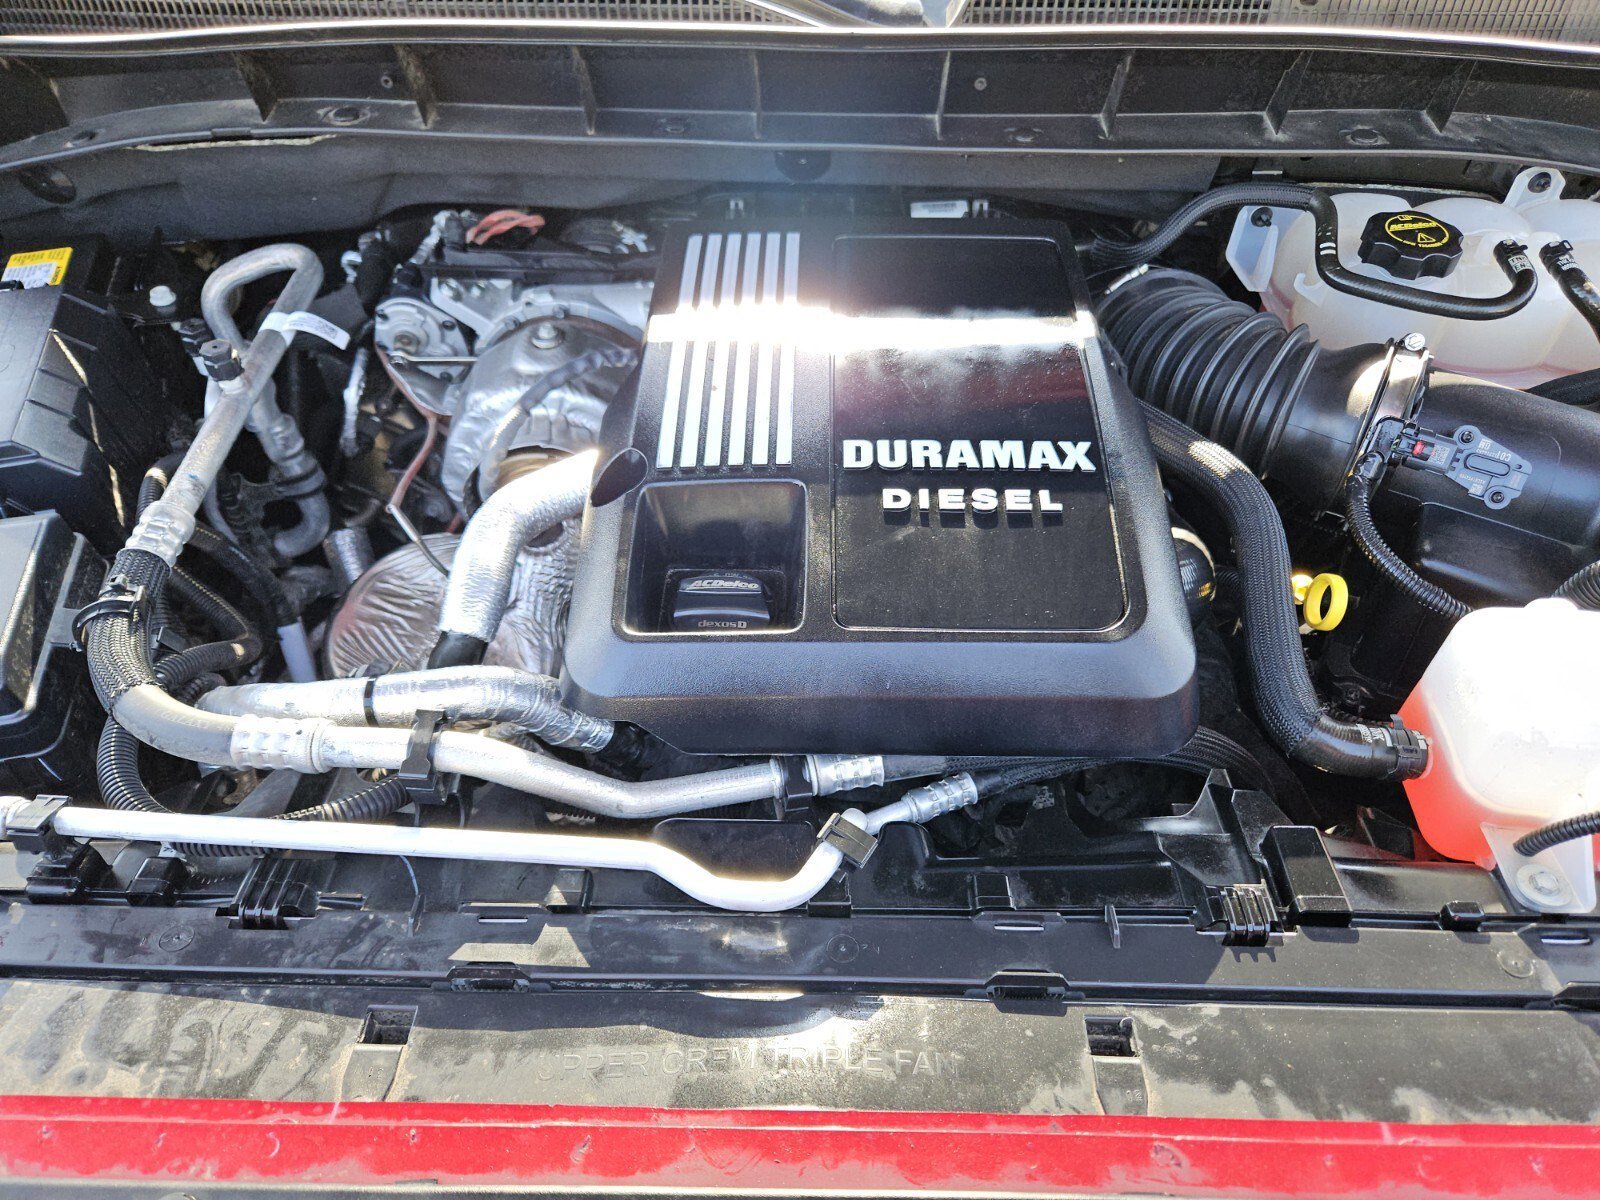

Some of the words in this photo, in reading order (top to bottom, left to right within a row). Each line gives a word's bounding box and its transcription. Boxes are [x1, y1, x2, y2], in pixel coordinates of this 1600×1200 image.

[843, 439, 1096, 472] DURAMAX
[882, 488, 1063, 513] DIESEL
[686, 579, 759, 590] ACDelco
